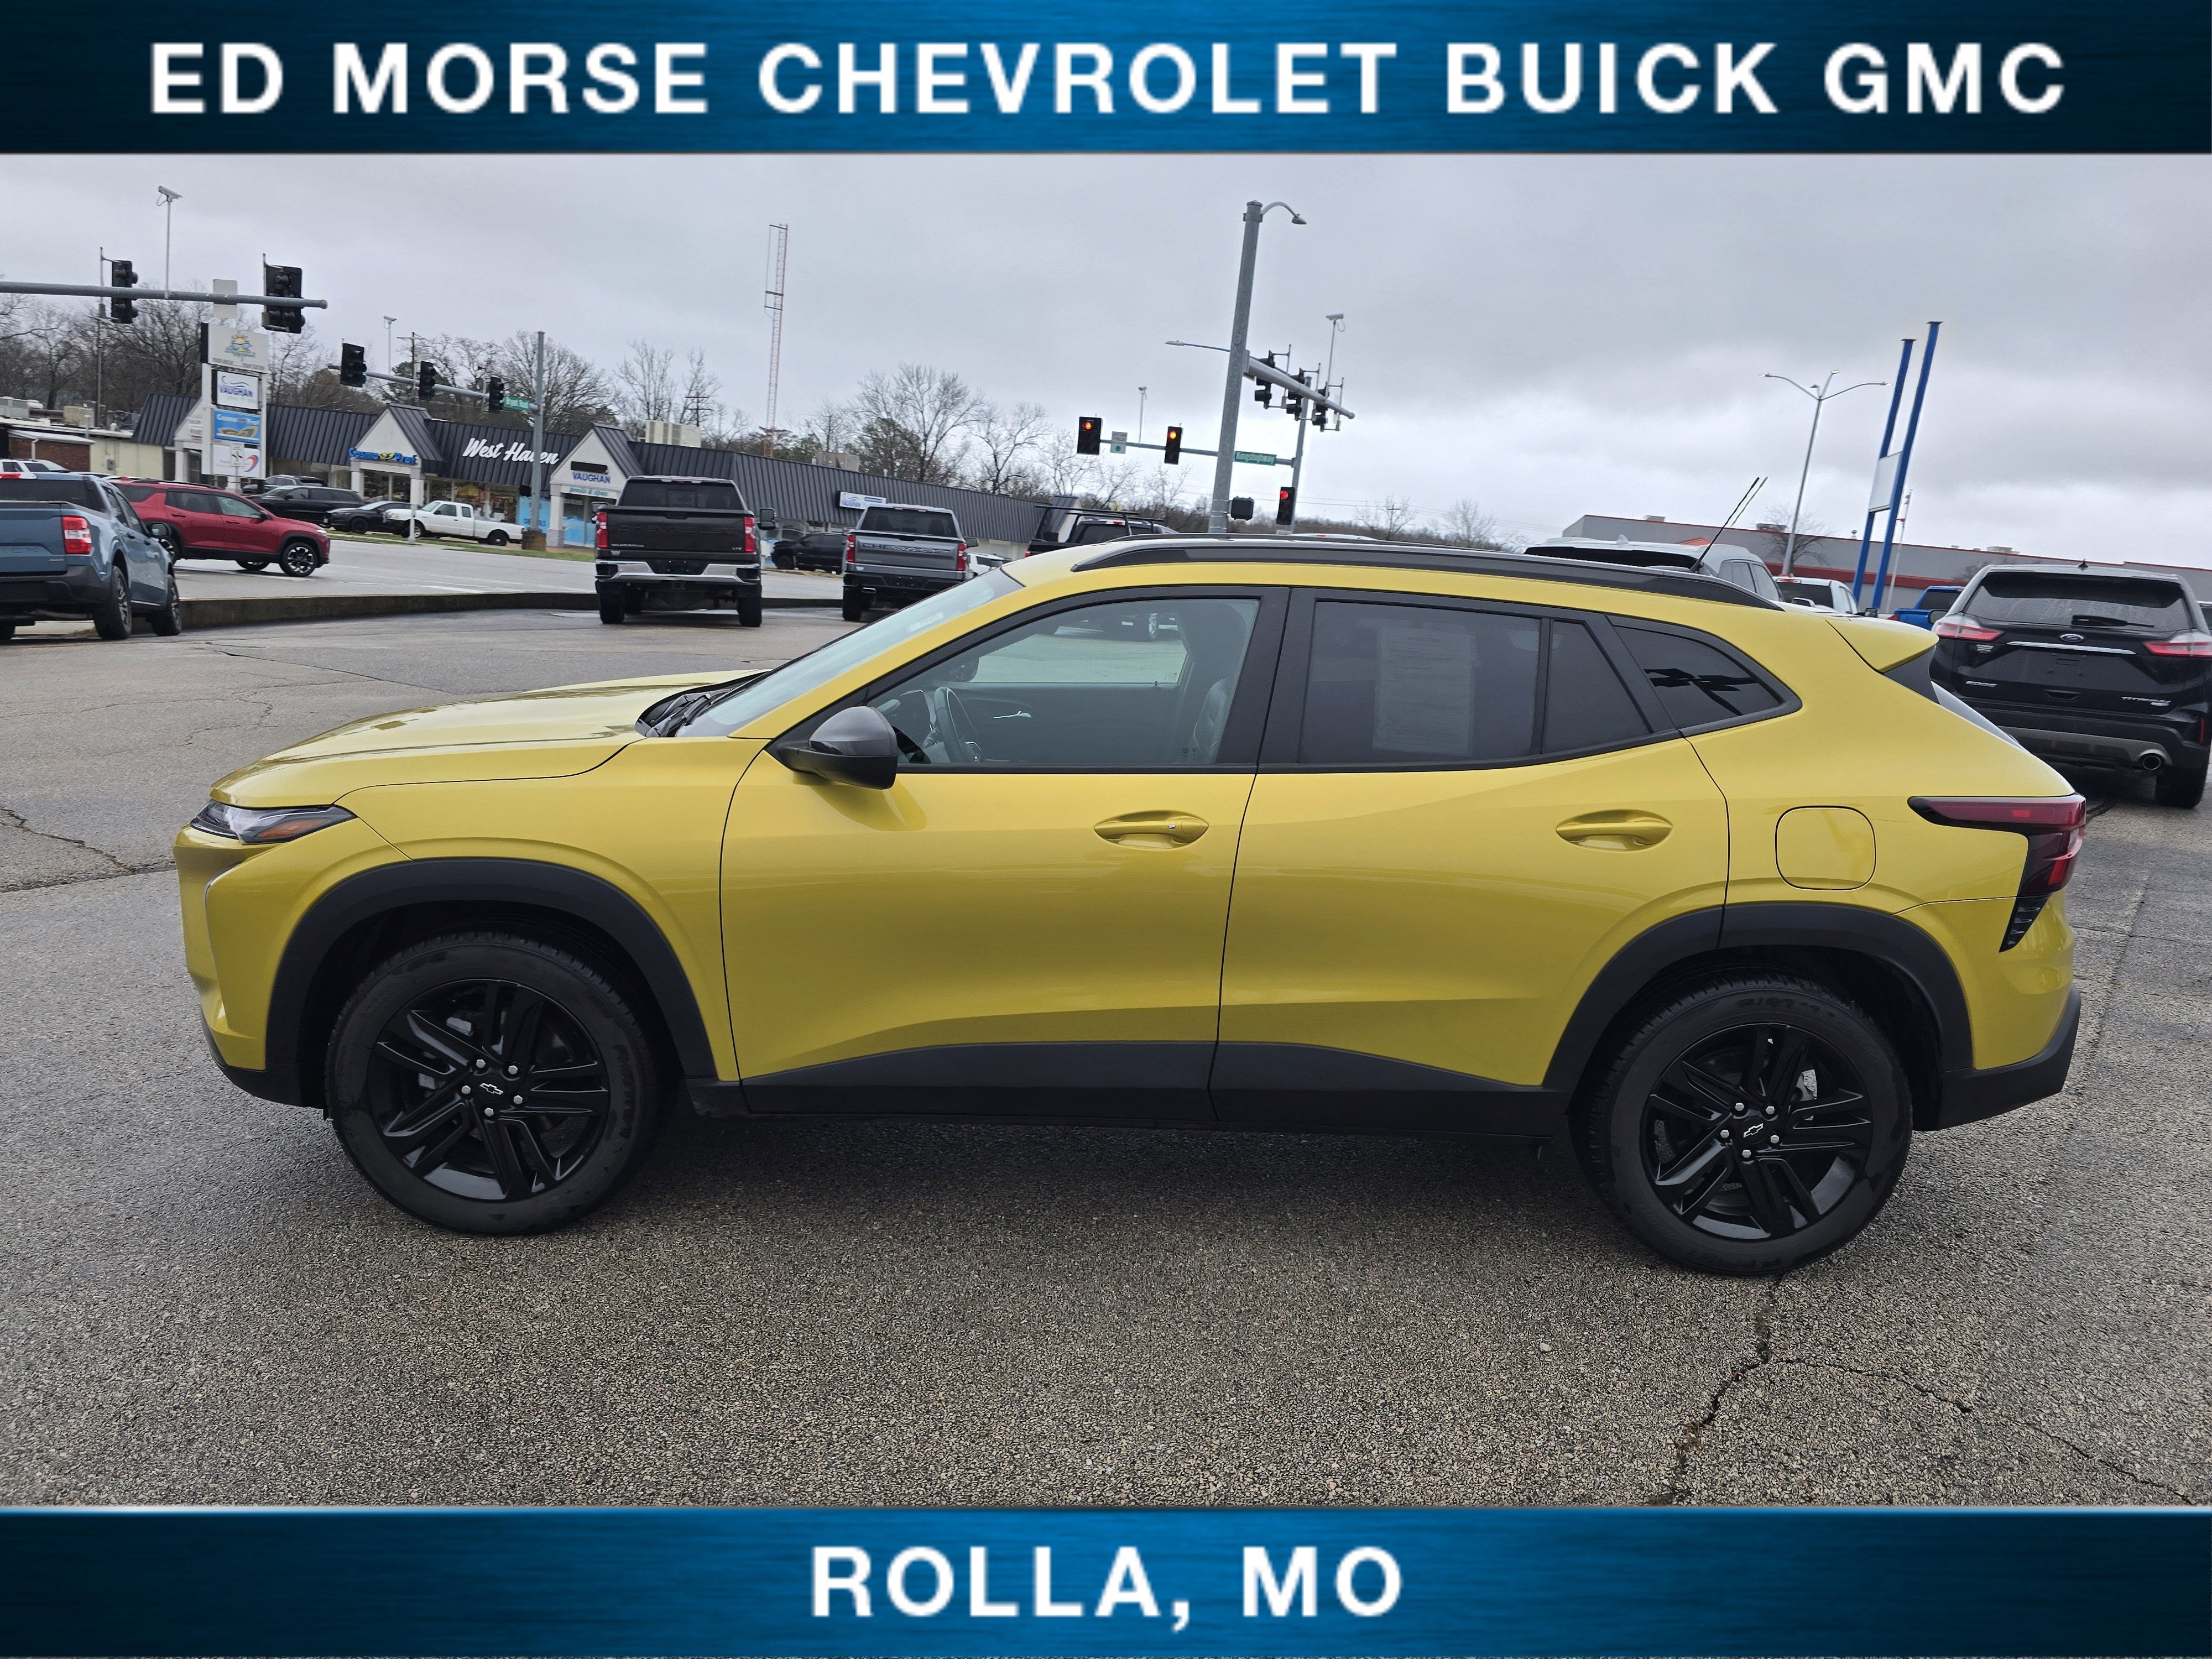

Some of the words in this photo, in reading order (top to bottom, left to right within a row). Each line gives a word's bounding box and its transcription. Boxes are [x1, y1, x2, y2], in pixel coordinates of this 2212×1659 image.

[220, 387, 253, 397] VAUGHAN
[462, 437, 505, 458] West
[572, 472, 611, 483] VAUGHAN
[862, 543, 952, 555] CHEVROLET
